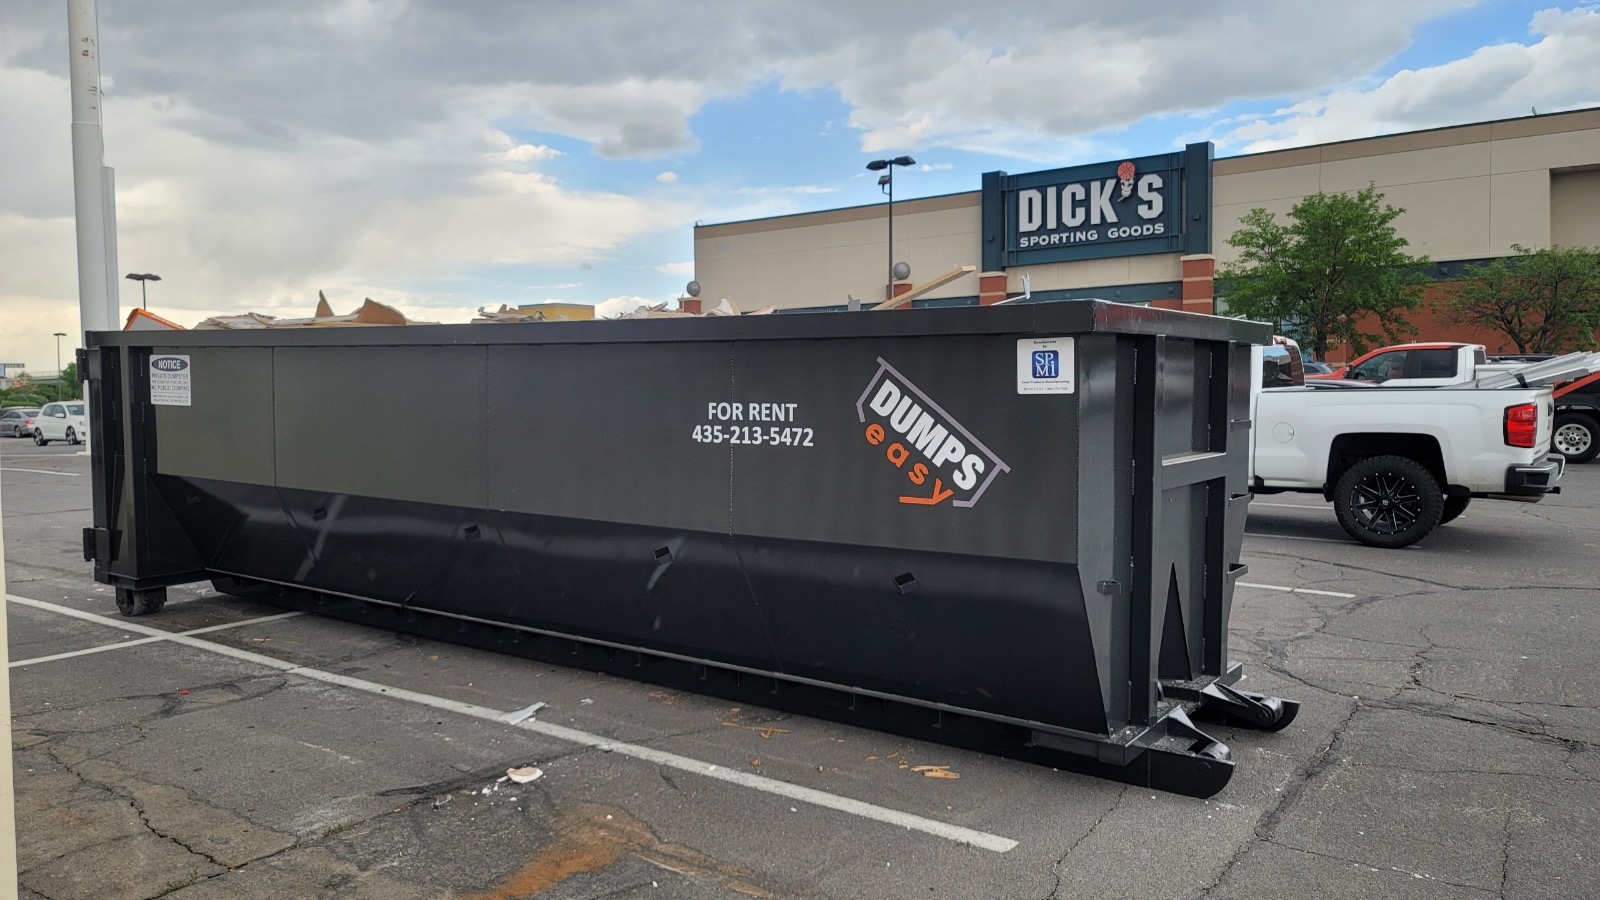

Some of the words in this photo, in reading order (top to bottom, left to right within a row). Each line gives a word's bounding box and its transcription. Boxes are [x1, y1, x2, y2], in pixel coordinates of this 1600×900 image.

[1019, 173, 1163, 233] DICK'S
[1019, 230, 1098, 248] SPORTING
[1107, 223, 1165, 239] GOODS
[158, 359, 182, 370] NOTICE
[708, 402, 743, 420] FOR
[749, 403, 798, 421] RENT
[692, 425, 814, 446] 435-213-5472
[869, 378, 985, 490] DUMPS
[865, 423, 955, 505] easy
